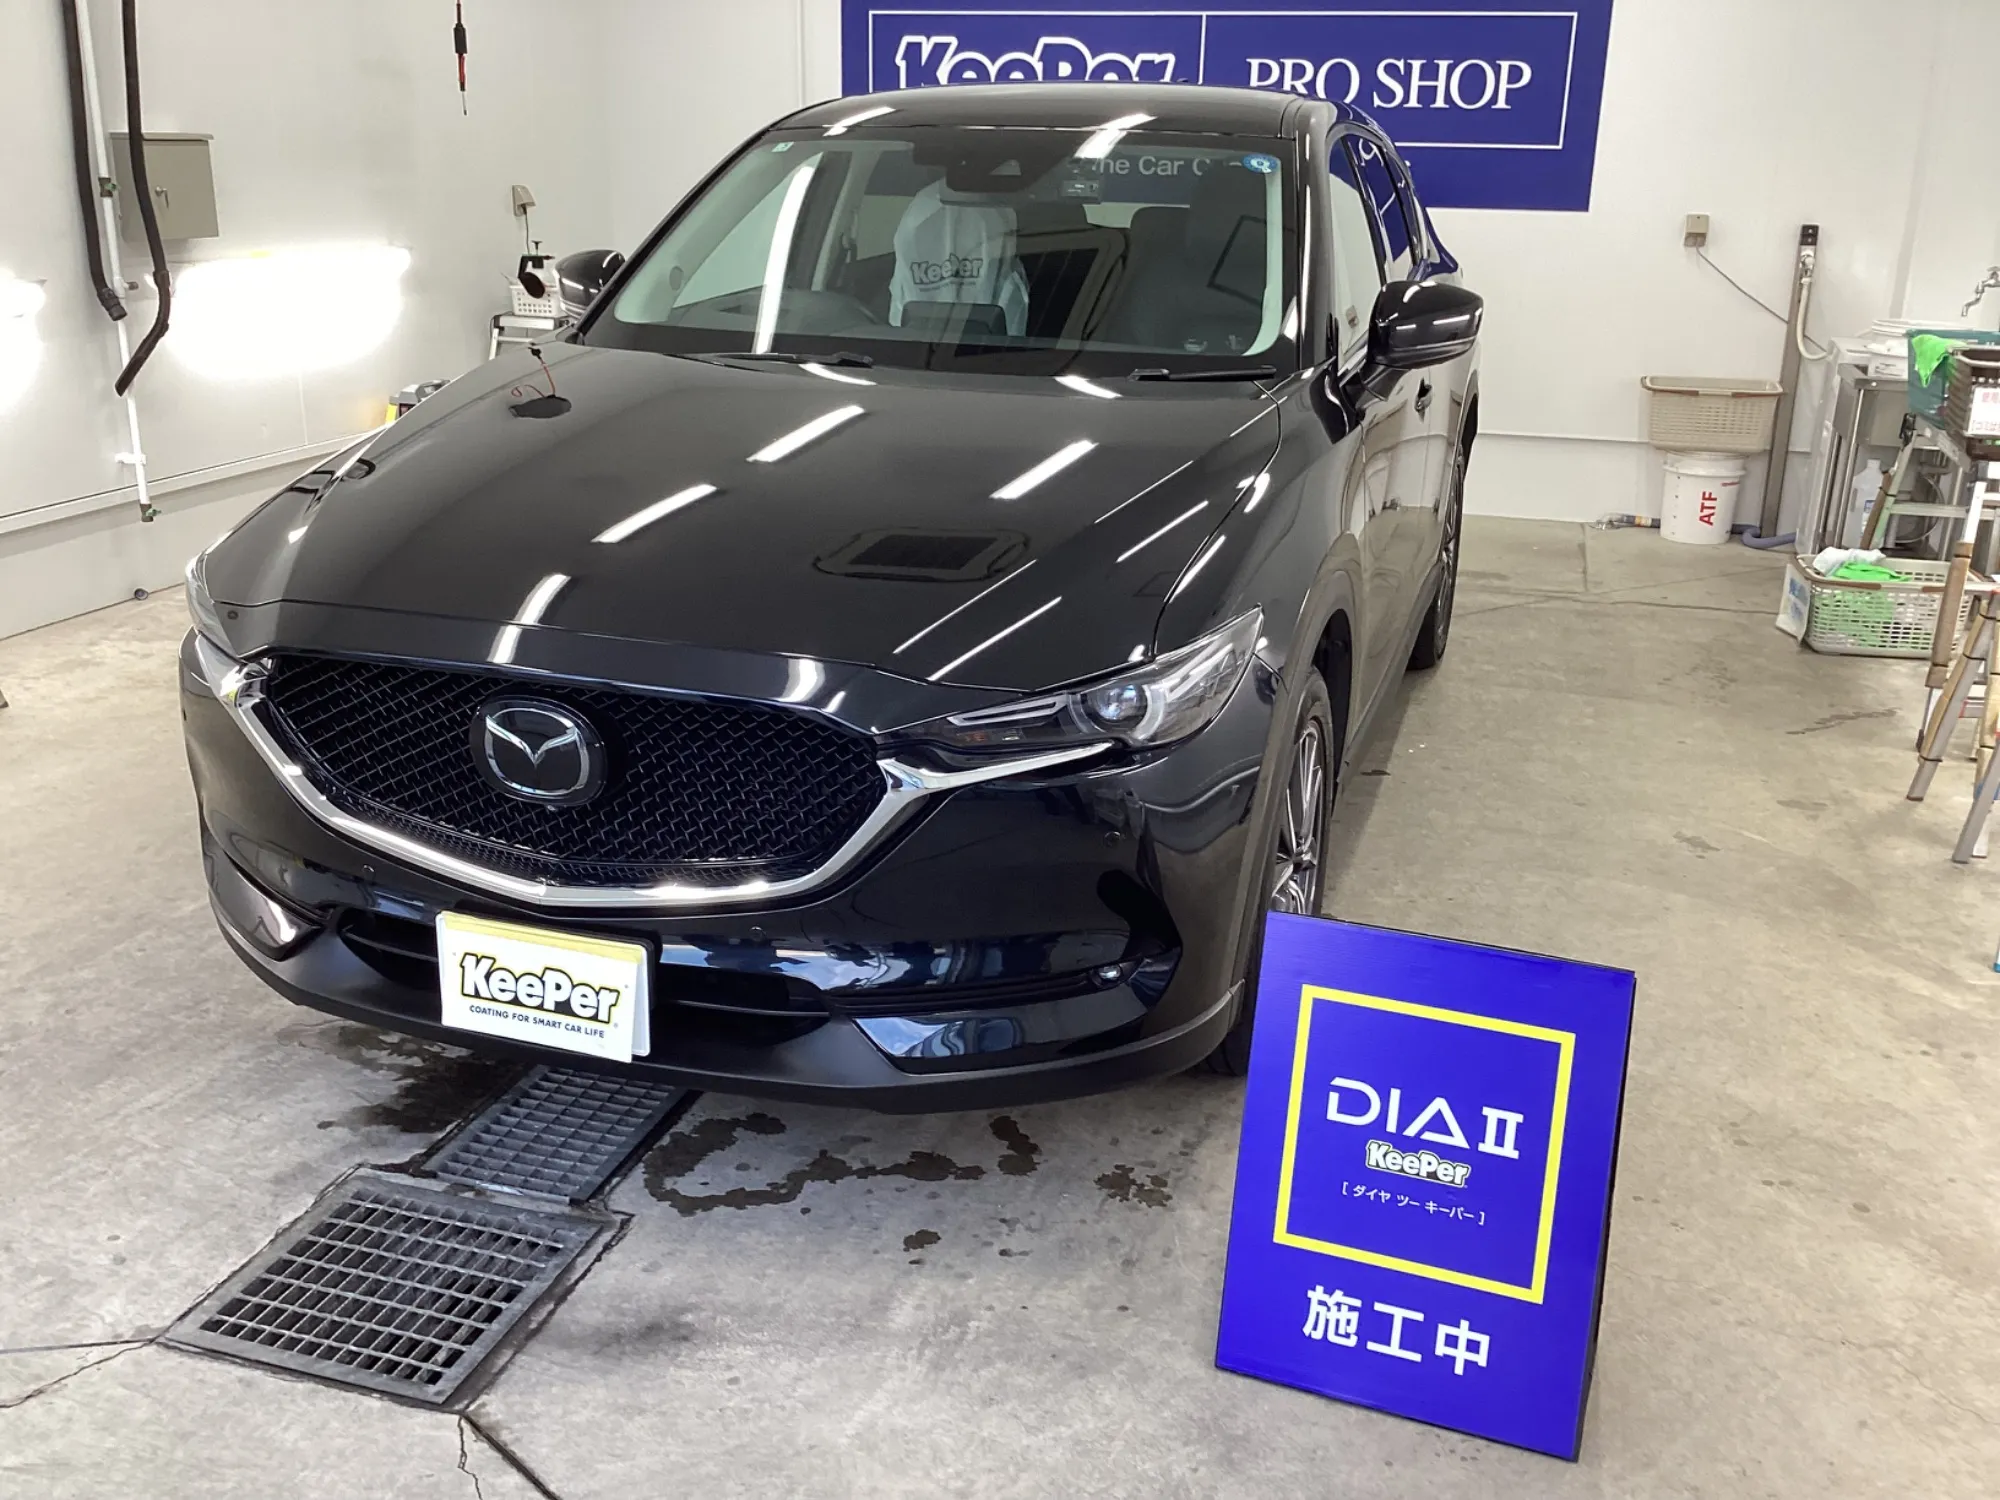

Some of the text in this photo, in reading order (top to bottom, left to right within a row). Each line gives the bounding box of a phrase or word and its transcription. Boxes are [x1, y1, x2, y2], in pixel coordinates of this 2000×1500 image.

[1246, 58, 1532, 110] PRO SHOP
[1092, 156, 1131, 175] he
[1138, 155, 1185, 176] Car
[1698, 490, 1718, 527] ATF
[459, 952, 620, 1024] KeePer
[469, 1004, 605, 1039] COATING FOR SMART CAR LIFE
[1326, 1076, 1470, 1149] DIA
[1365, 1139, 1471, 1188] KeePer
[1302, 1284, 1491, 1376] 施工中
